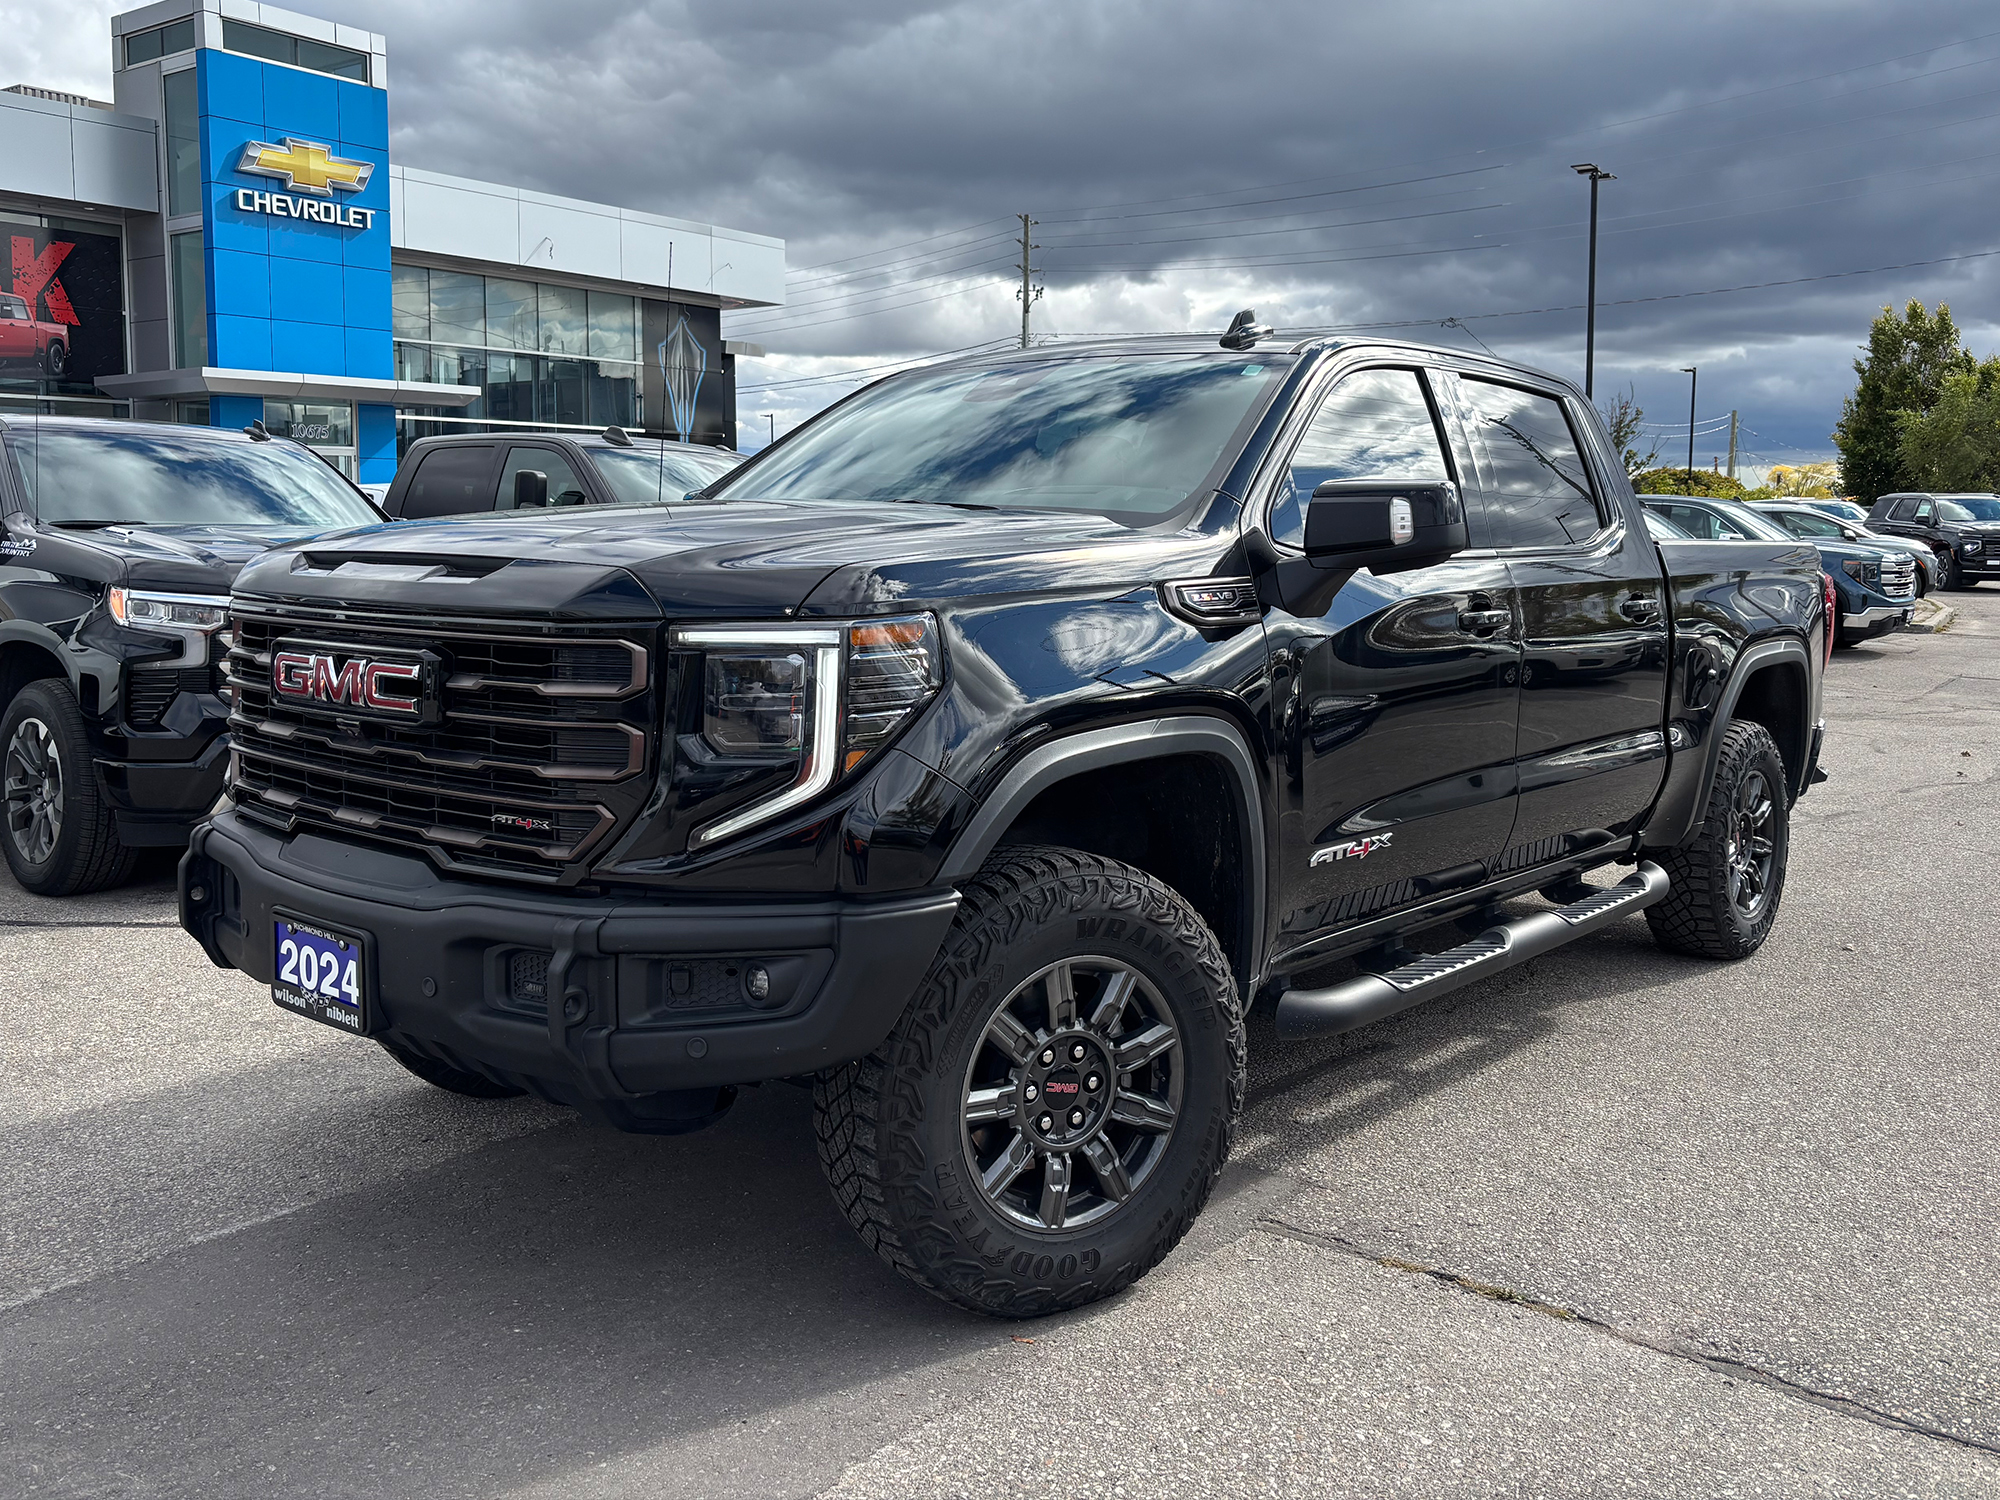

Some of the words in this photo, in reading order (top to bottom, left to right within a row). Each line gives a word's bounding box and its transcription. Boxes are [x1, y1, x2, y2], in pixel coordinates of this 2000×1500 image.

[238, 188, 375, 229] CHEVROLET
[0, 235, 81, 326] K
[291, 423, 330, 440] 10675
[0, 547, 33, 557] OUNTRY
[274, 651, 421, 714] GMC
[490, 813, 550, 830] AT4X
[1309, 832, 1394, 868] AT4X
[292, 921, 323, 938] RICHMOND
[323, 930, 338, 943] HILL
[280, 939, 360, 1005] 2024
[1076, 916, 1217, 1030] WRANGLER
[274, 988, 307, 1009] wilson
[326, 1005, 360, 1029] niblett
[1045, 1082, 1079, 1094] GMC
[1178, 1105, 1222, 1201] TERRITORY
[934, 1159, 1101, 1281] GOODYEAR
